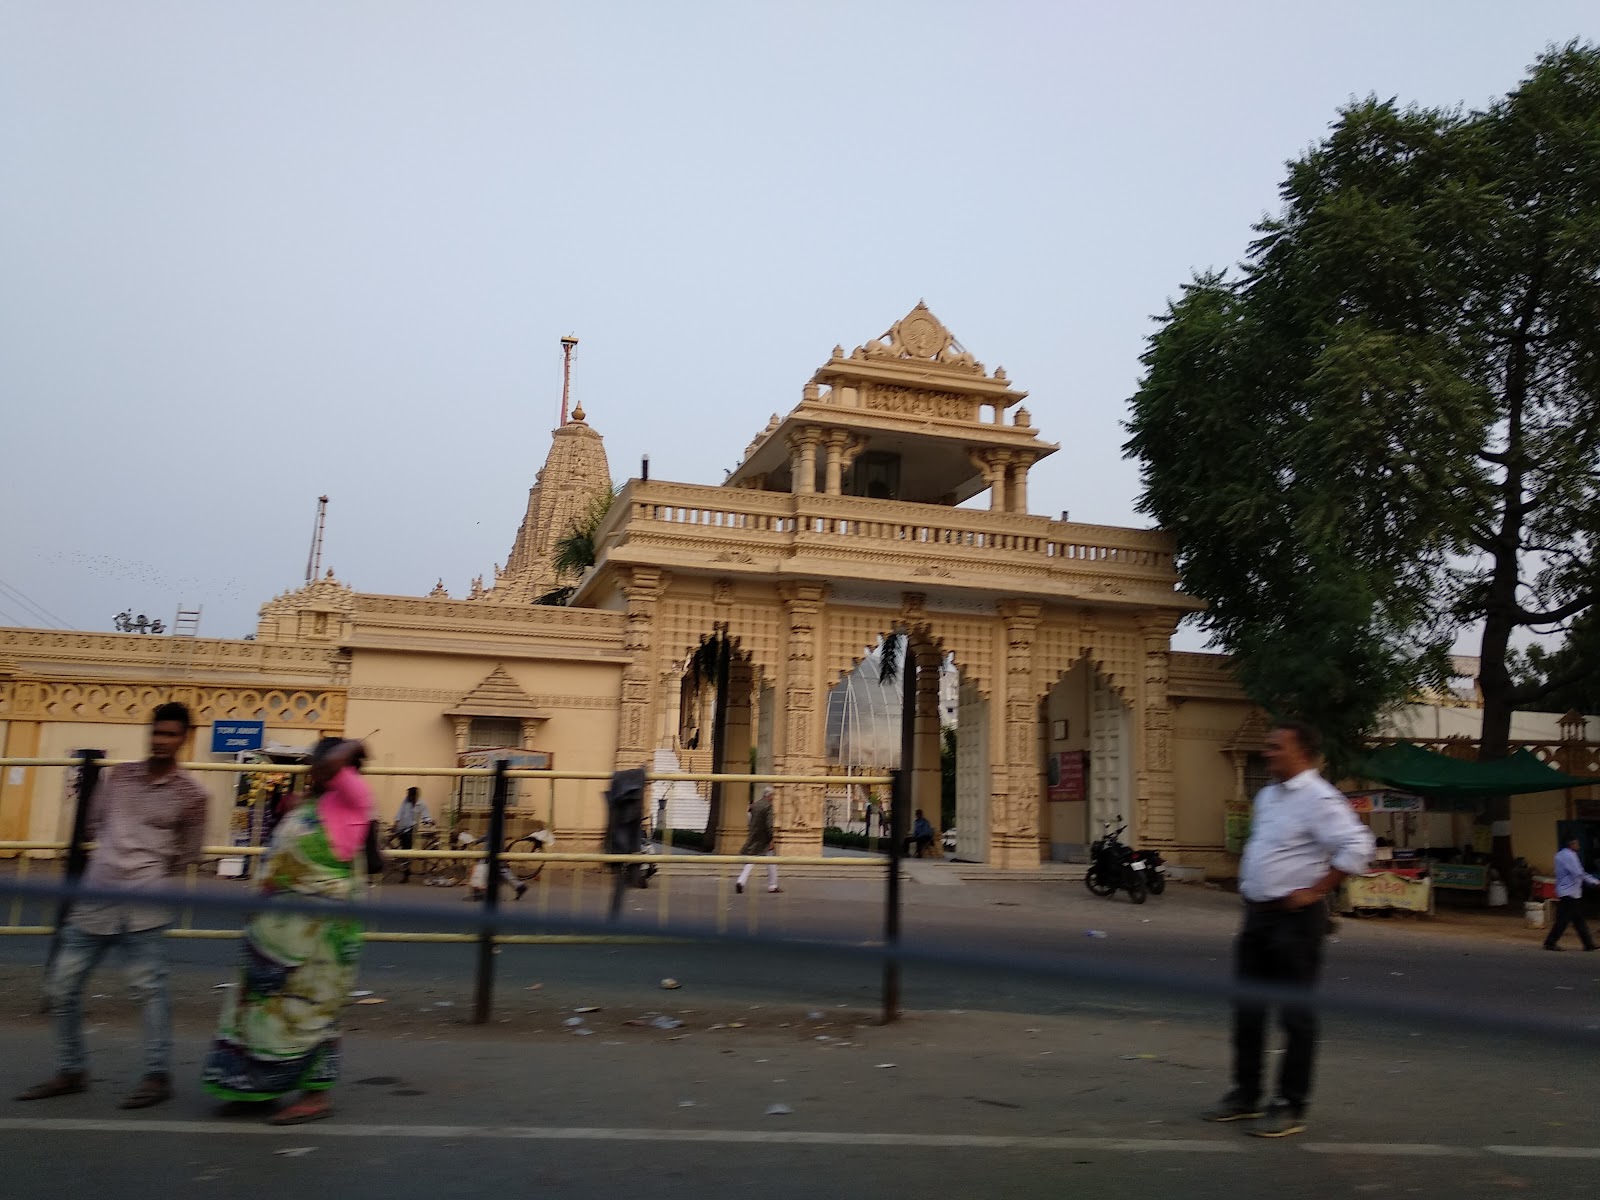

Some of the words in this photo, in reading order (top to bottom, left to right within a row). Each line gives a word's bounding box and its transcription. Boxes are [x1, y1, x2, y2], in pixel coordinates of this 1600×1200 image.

[216, 726, 237, 734] TOW
[236, 727, 260, 735] AWAY
[225, 738, 249, 746] ZONE
